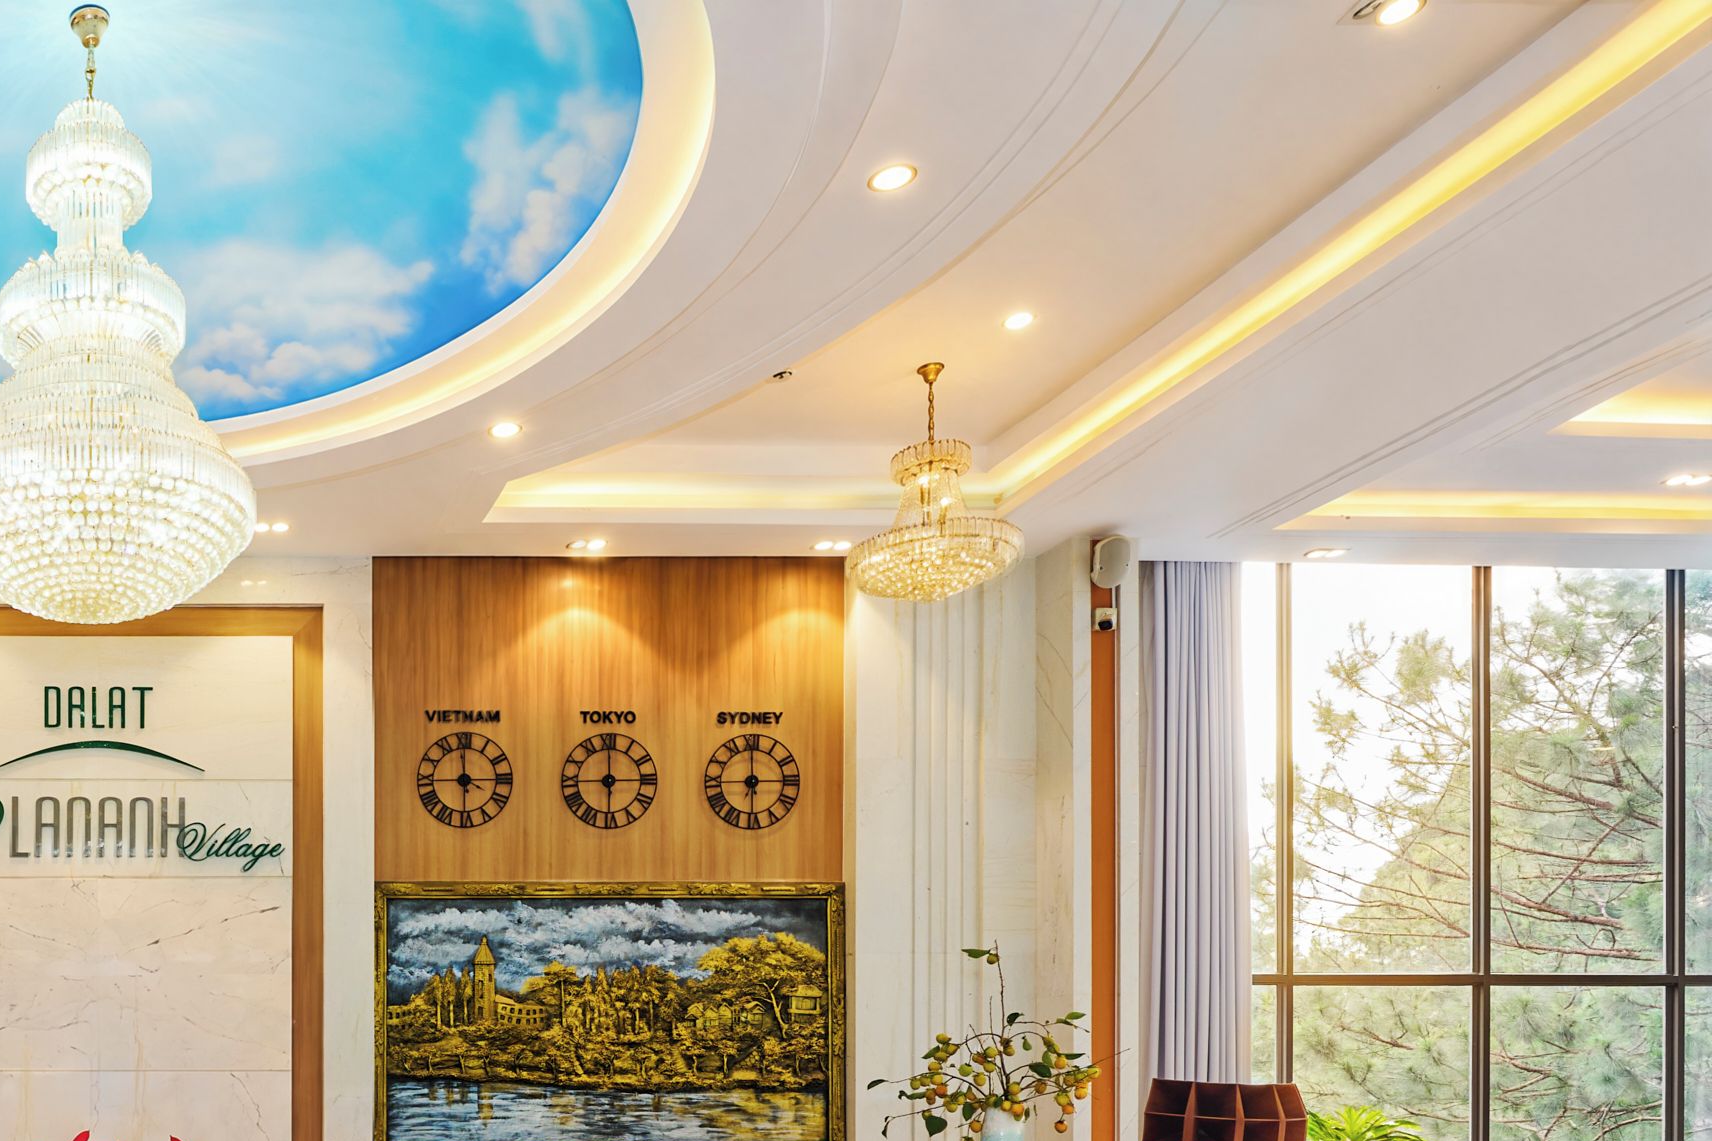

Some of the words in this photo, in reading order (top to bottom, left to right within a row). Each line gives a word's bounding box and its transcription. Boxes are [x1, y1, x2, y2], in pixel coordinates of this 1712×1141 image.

[44, 686, 154, 729] DALAT
[424, 709, 501, 724] VIETNAM
[579, 710, 637, 725] TOKYO
[716, 711, 784, 725] SYDNEY
[176, 822, 285, 872] Village
